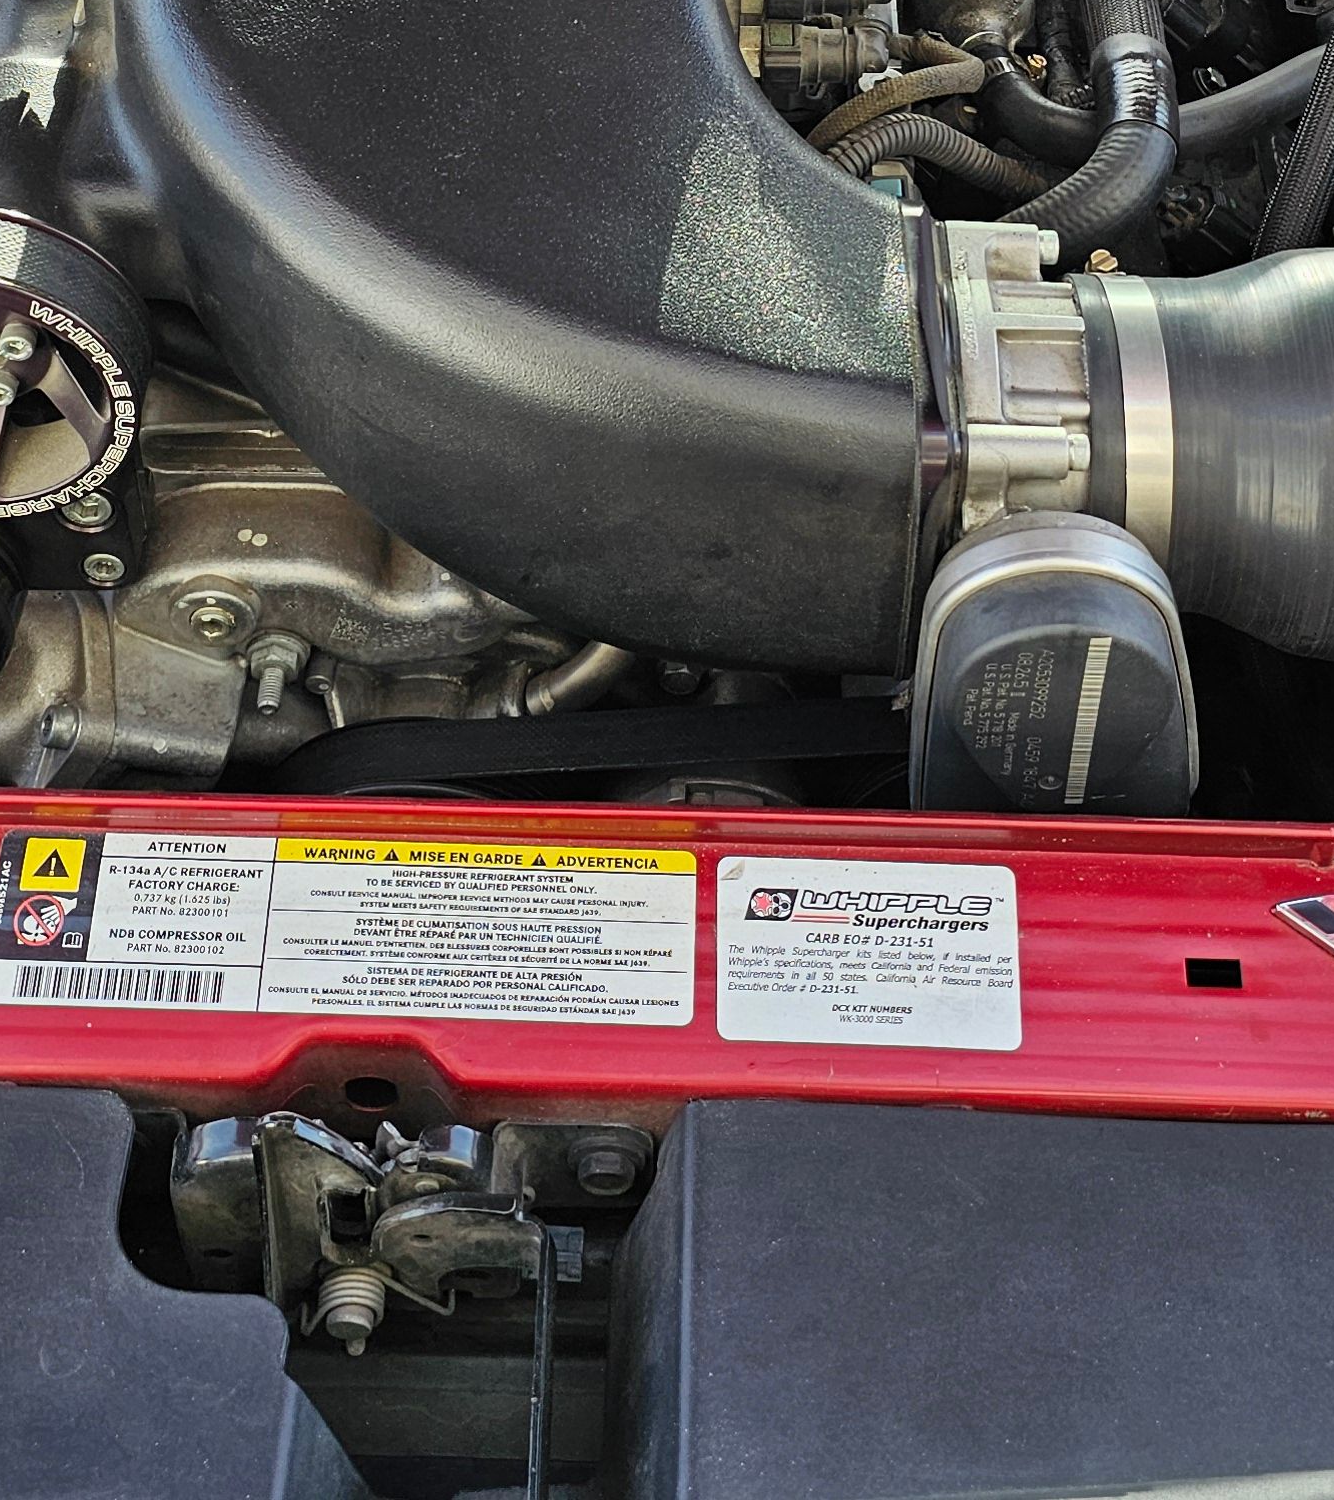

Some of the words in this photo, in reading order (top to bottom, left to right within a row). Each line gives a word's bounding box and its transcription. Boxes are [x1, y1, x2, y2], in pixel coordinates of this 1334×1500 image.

[29, 301, 133, 399] WHIPPLE
[146, 840, 227, 854] ATTENTION
[108, 864, 150, 875] R-134a
[152, 865, 177, 878] A/C
[179, 866, 264, 879] REFRIGERANT
[127, 878, 184, 890] FACTORY
[186, 880, 240, 892] CHARGE:
[133, 892, 162, 902] 0.737
[178, 893, 210, 905] (1.625
[212, 894, 231, 907] lbs)
[131, 905, 158, 915] PART
[159, 905, 176, 916] No.
[177, 906, 228, 917] 82300101
[108, 927, 134, 939] ND8
[137, 928, 223, 941] COMPRESSOR
[225, 931, 246, 942] OIL
[126, 942, 152, 952] PART
[154, 943, 171, 953] No.
[173, 944, 225, 955] 82300102
